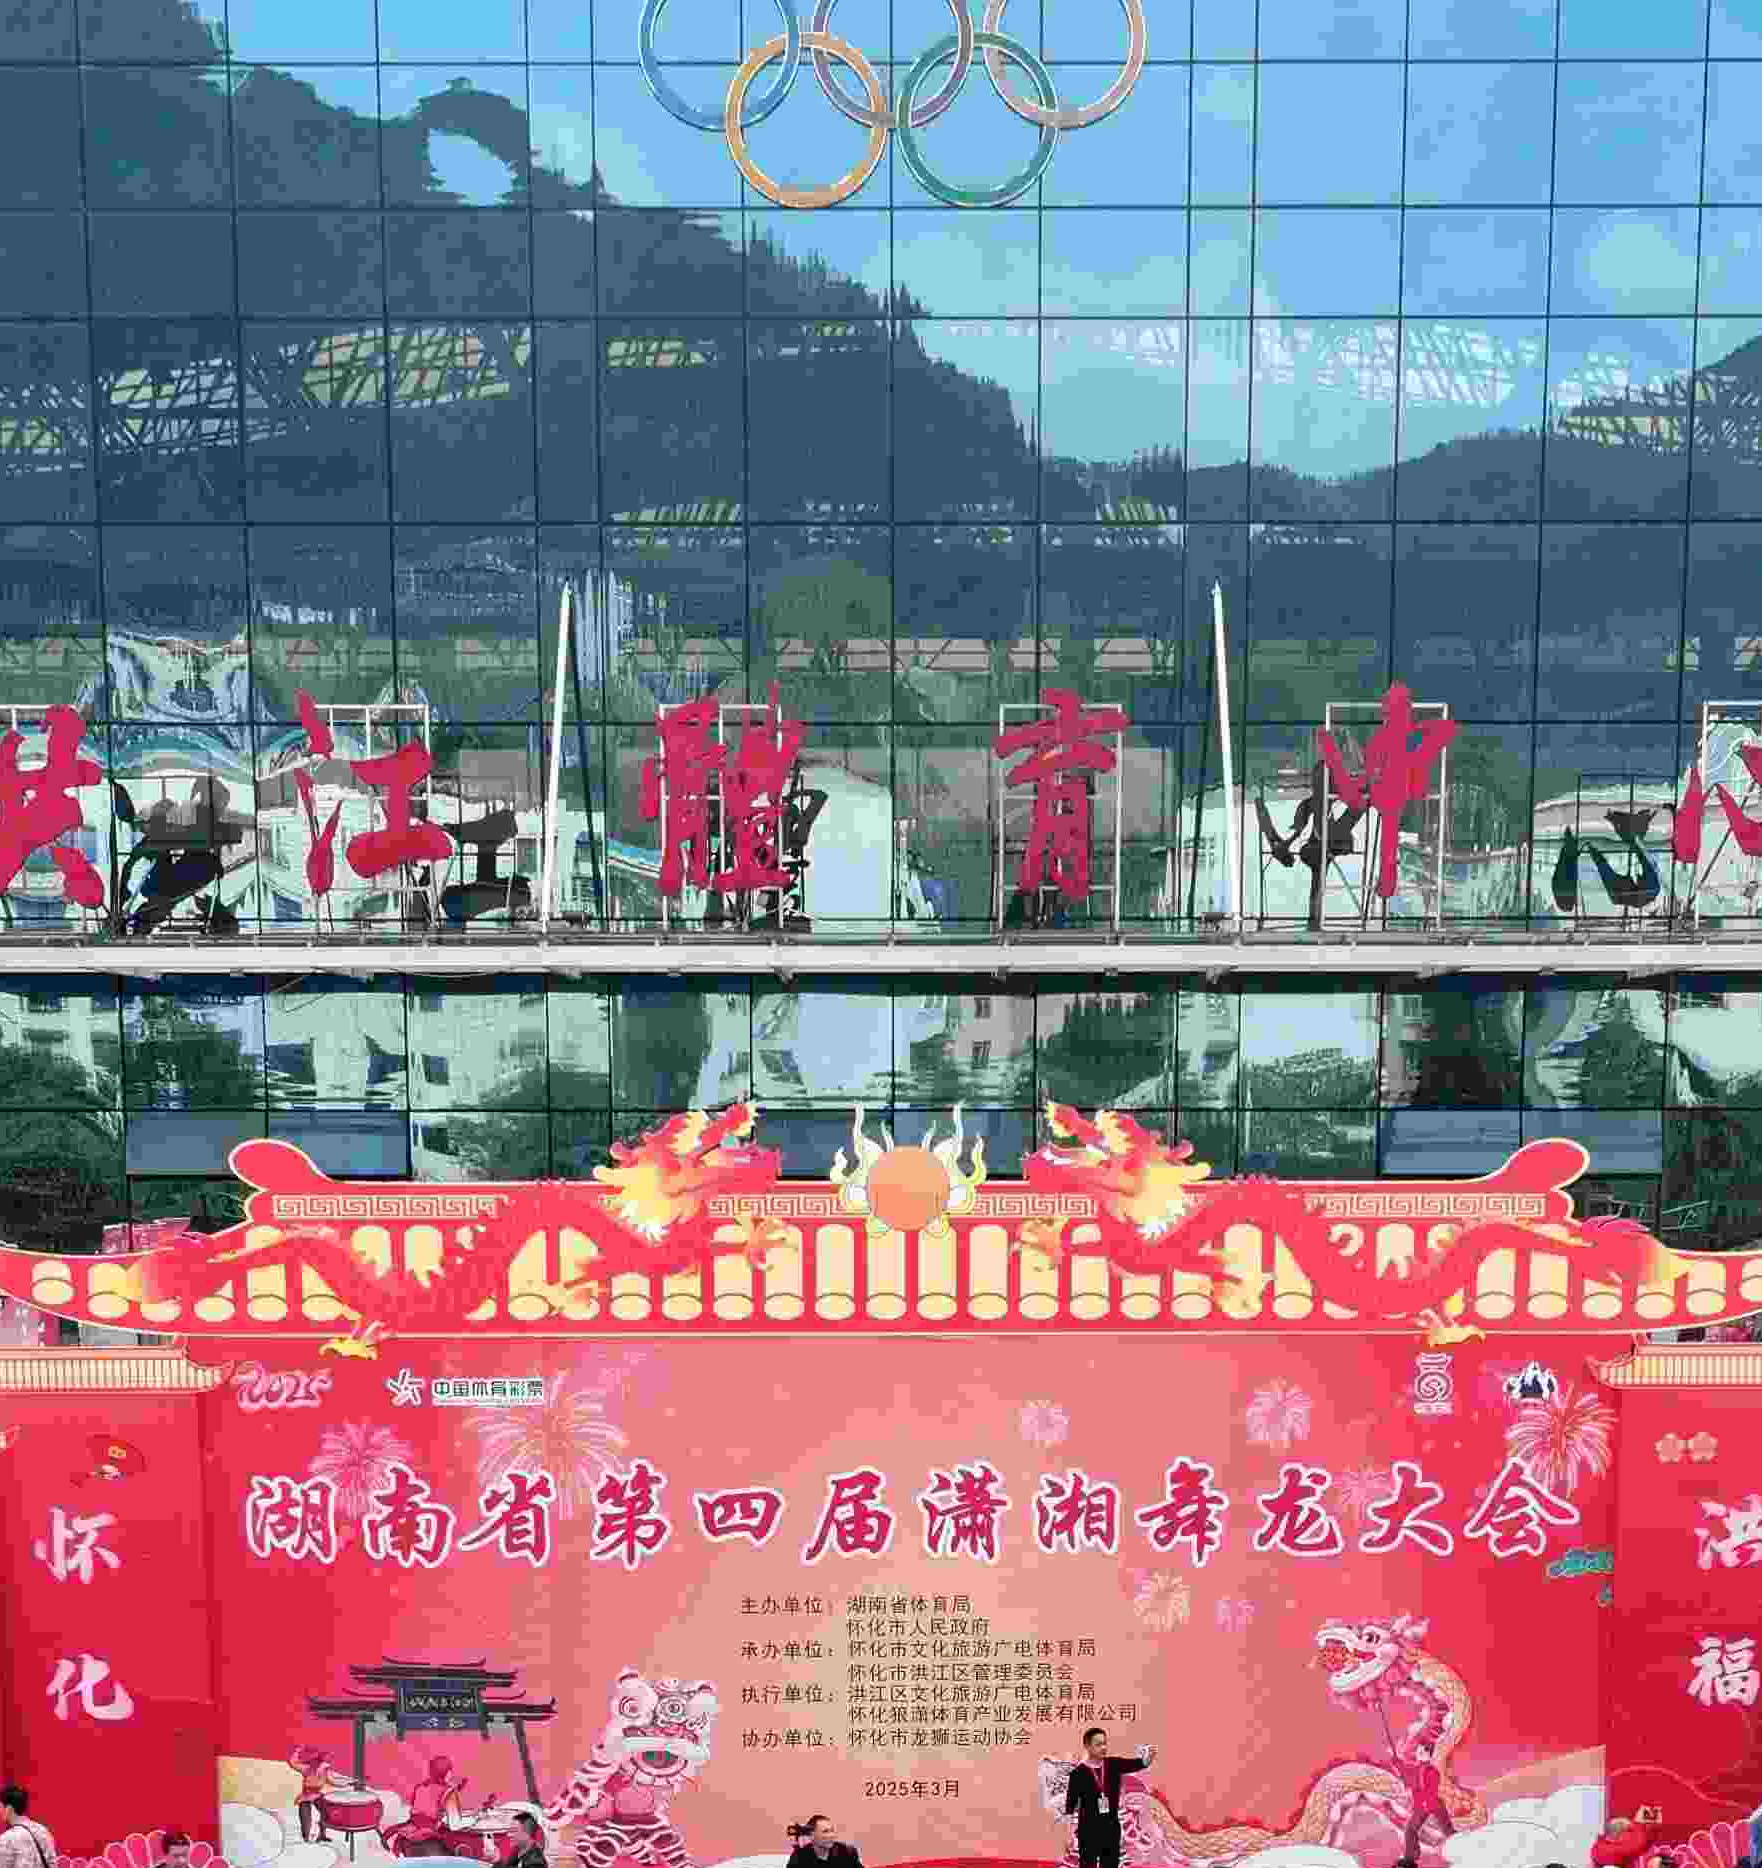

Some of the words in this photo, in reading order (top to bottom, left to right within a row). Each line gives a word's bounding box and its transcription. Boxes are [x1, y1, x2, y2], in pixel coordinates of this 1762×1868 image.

[433, 1377, 543, 1397] 中国体育彩票
[245, 1456, 1580, 1571] 湖南省第四届潇湘舞龙大会
[34, 1505, 135, 1723] 怀化
[847, 1595, 973, 1615] 湖南省体育局
[846, 1617, 990, 1637] 怀化市人民政府
[847, 1639, 1095, 1658] 怀化市文化旅游广电体育局
[847, 1663, 1075, 1682] 怀化市洪江区管理委员会
[847, 1683, 1095, 1702] 洪江区文化旅游广电体育局
[847, 1728, 1032, 1748] 怀化市龙狮运动协会
[865, 1780, 960, 1799] 2025年3月
